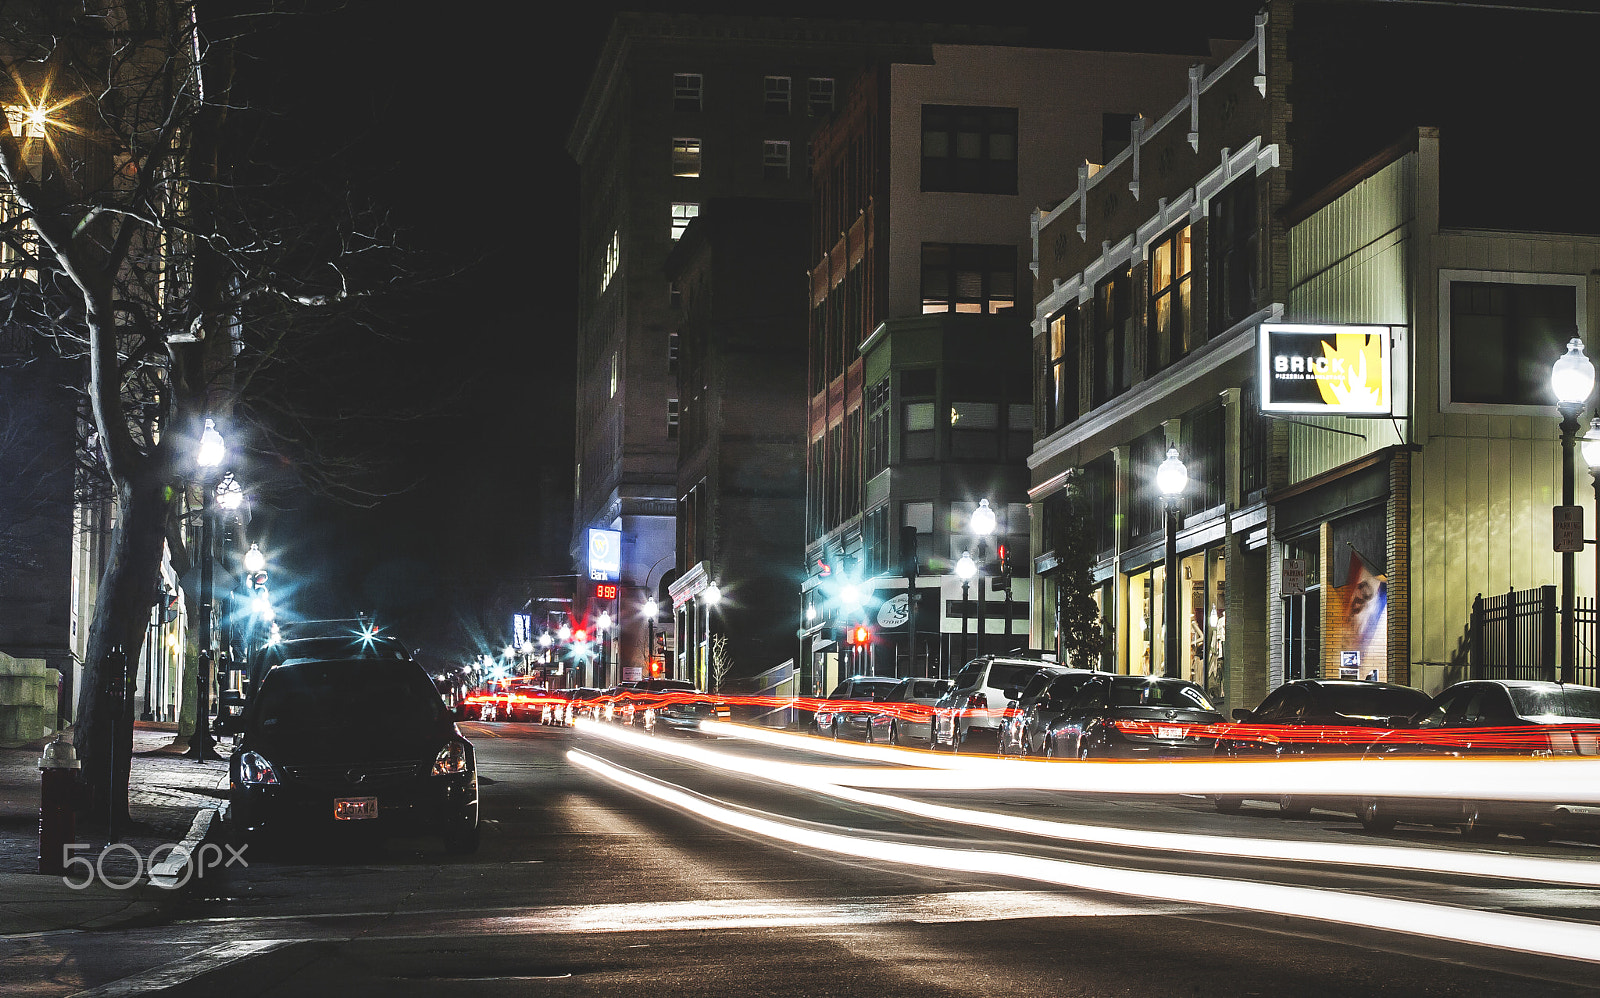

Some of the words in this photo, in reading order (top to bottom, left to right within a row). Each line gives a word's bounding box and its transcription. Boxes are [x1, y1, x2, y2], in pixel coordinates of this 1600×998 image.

[1274, 354, 1345, 373] BRICK
[1563, 511, 1574, 521] NO
[1555, 521, 1582, 529] PARKING
[1562, 538, 1574, 546] TIME
[1289, 560, 1299, 569] NO
[591, 569, 608, 581] Bank
